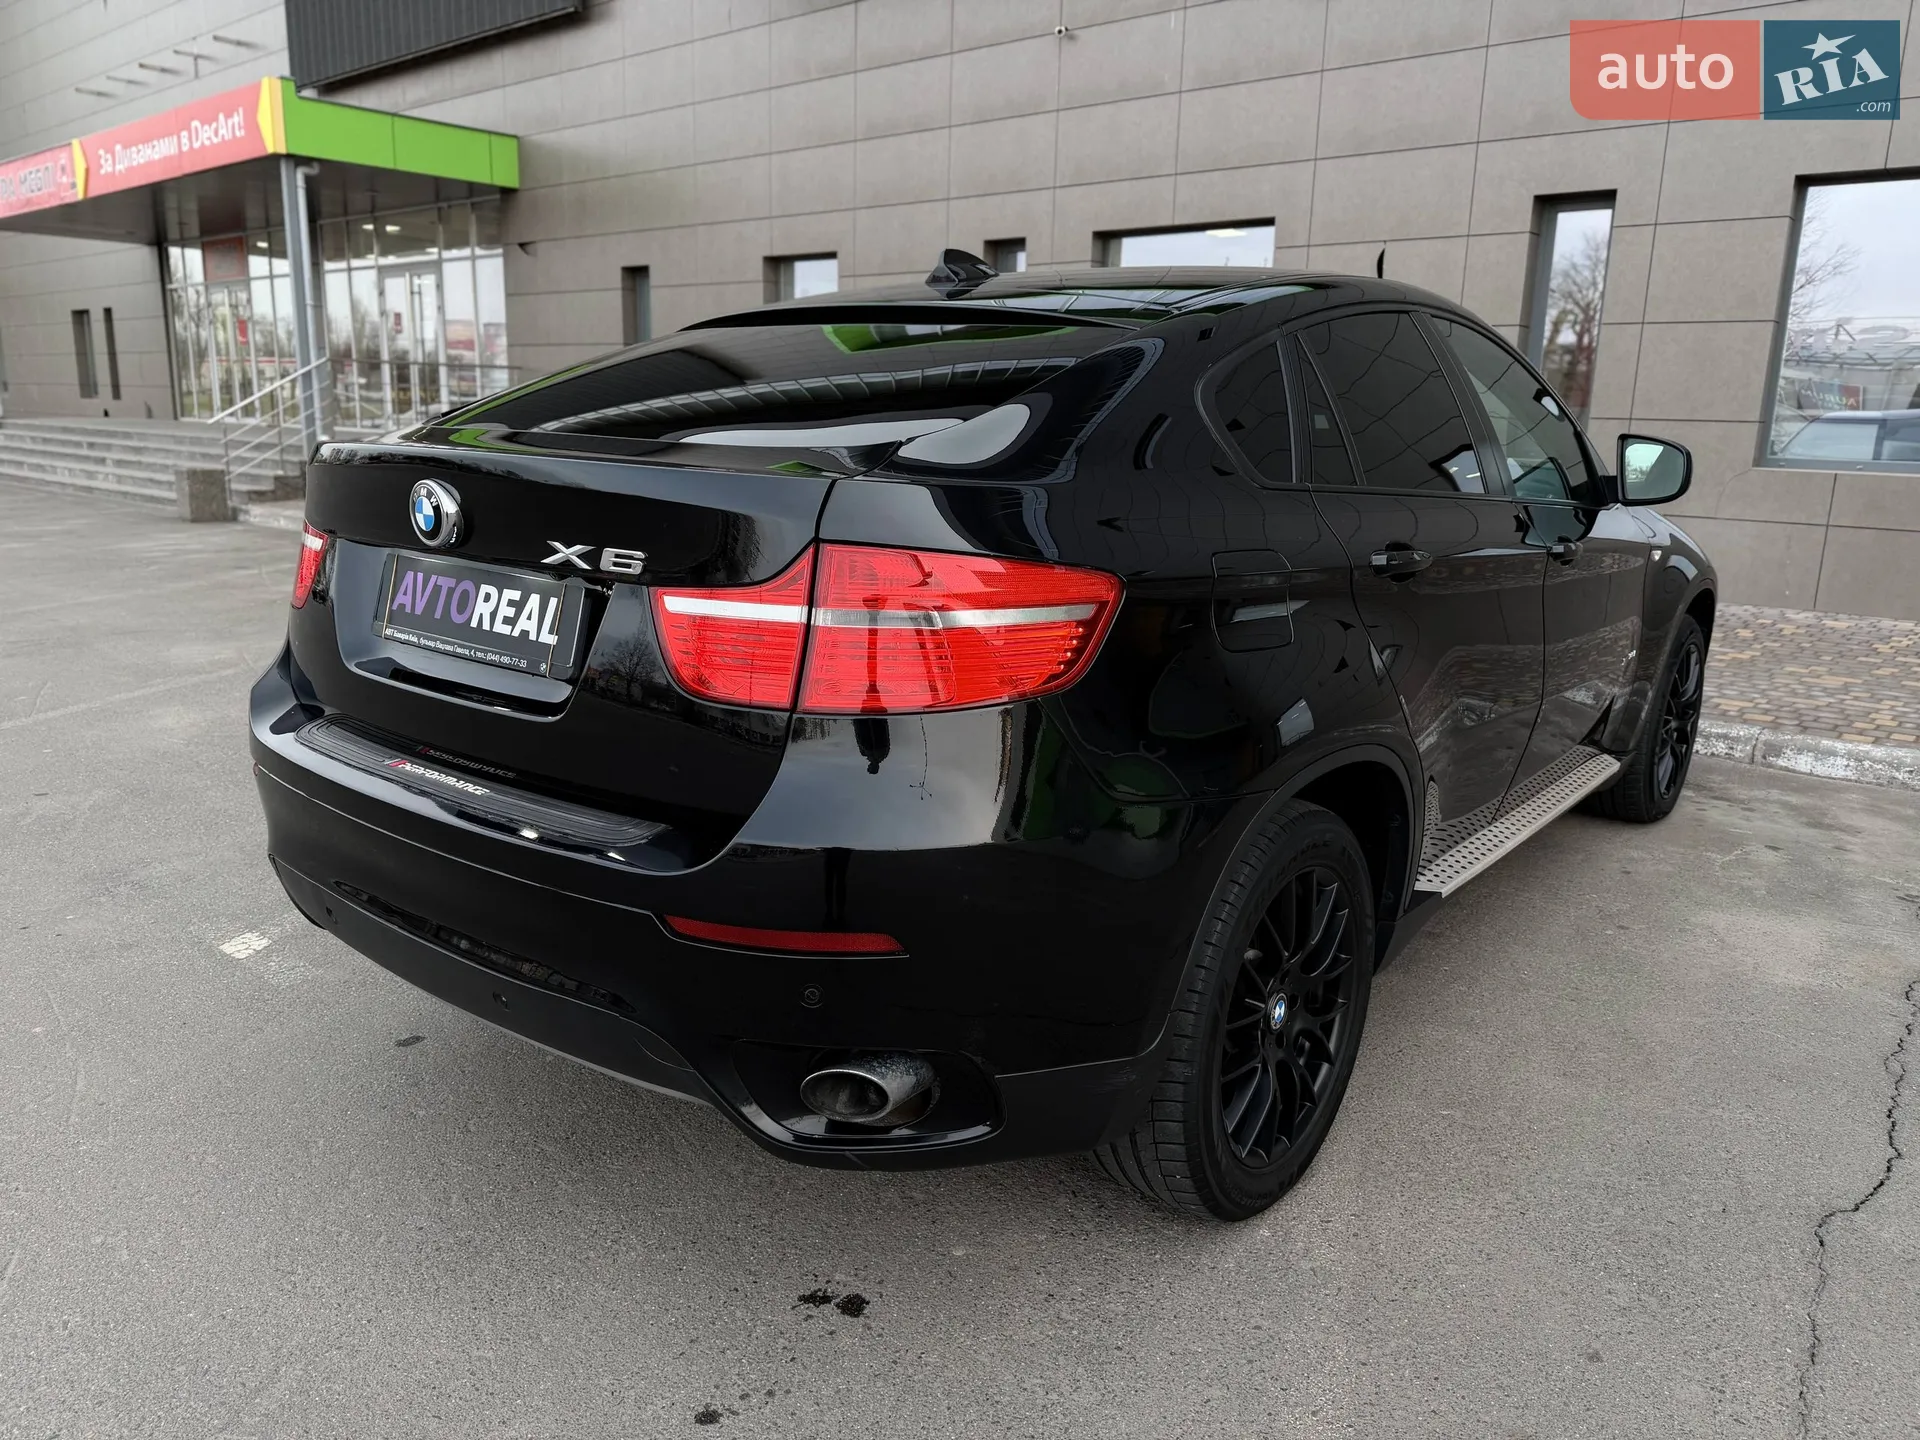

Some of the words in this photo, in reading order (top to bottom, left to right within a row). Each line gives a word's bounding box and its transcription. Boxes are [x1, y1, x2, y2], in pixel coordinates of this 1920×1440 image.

[98, 148, 113, 175] За
[114, 134, 179, 175] Диванами
[180, 130, 190, 152] в
[190, 107, 245, 149] DecArt!
[540, 540, 648, 575] X6
[391, 570, 560, 646] AVTOREAL
[487, 653, 499, 663] (044)
[500, 656, 527, 667] 490-77-33
[398, 761, 490, 796] PERFORMANCE
